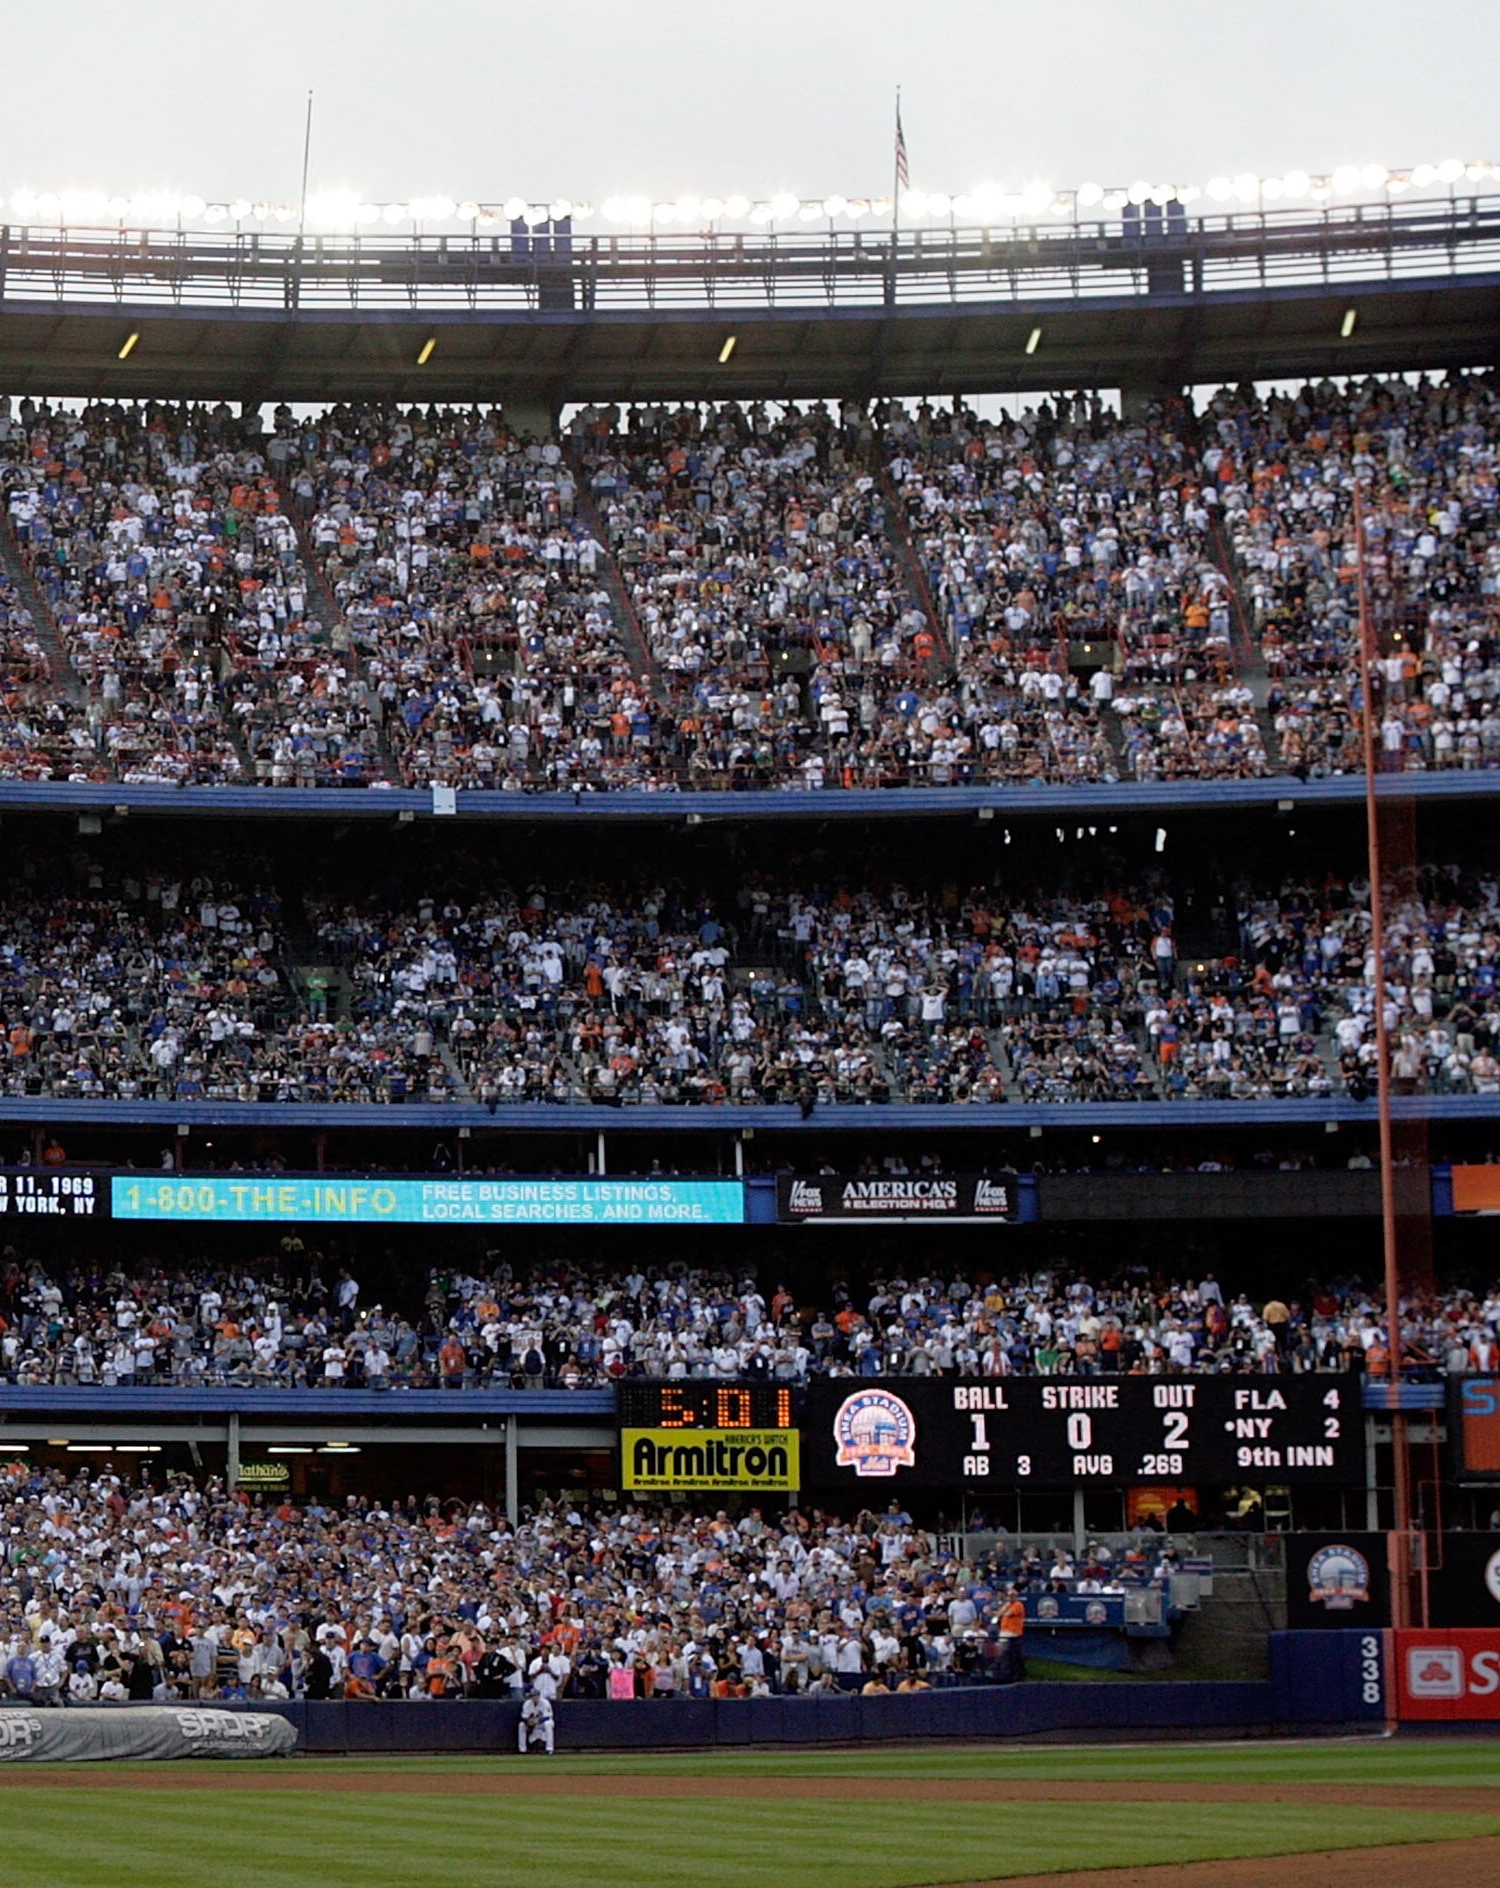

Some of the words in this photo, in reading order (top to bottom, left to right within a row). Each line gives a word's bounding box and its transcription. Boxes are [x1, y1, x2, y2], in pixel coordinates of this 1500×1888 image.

[51, 1177, 94, 1195] 1969
[422, 1184, 473, 1200] FREE
[479, 1185, 577, 1201] BUSINESS
[583, 1186, 677, 1203] LISTINGS,
[800, 1187, 822, 1197] FOX
[842, 1182, 957, 1199] AMERICA'S
[986, 1186, 1007, 1196] FOX
[15, 1196, 66, 1215] YORK,
[74, 1197, 95, 1214] NY
[128, 1185, 397, 1214] 1-800-THE-INFO
[853, 1199, 920, 1209] ELECTION
[422, 1204, 483, 1219] LOCAL
[490, 1204, 598, 1221] SEARCHES,
[603, 1205, 641, 1219] AND
[648, 1205, 709, 1220] MORE.
[661, 1388, 790, 1428] 5:01
[954, 1387, 1008, 1410] BALL
[1042, 1386, 1119, 1409] STRIKE
[1153, 1385, 1196, 1408] OUT
[1234, 1389, 1287, 1410] FLA
[1323, 1389, 1340, 1409] 4
[862, 1396, 908, 1441] STADIUM
[1236, 1418, 1273, 1438] NY
[1324, 1417, 1340, 1438] 2
[970, 1413, 990, 1450] 1
[1067, 1412, 1092, 1449] 0
[1162, 1411, 1189, 1449] 2
[634, 1437, 789, 1476] Armitron
[963, 1455, 989, 1476] AB
[1017, 1455, 1031, 1475] 3
[1073, 1455, 1113, 1475] AVG
[1137, 1454, 1183, 1475] .269
[1237, 1446, 1281, 1467] 9th
[1287, 1446, 1334, 1466] INN
[634, 1478, 671, 1486] Armitron
[673, 1478, 710, 1486] Armitron
[712, 1478, 749, 1486] Armitron
[751, 1478, 788, 1486] Armitron
